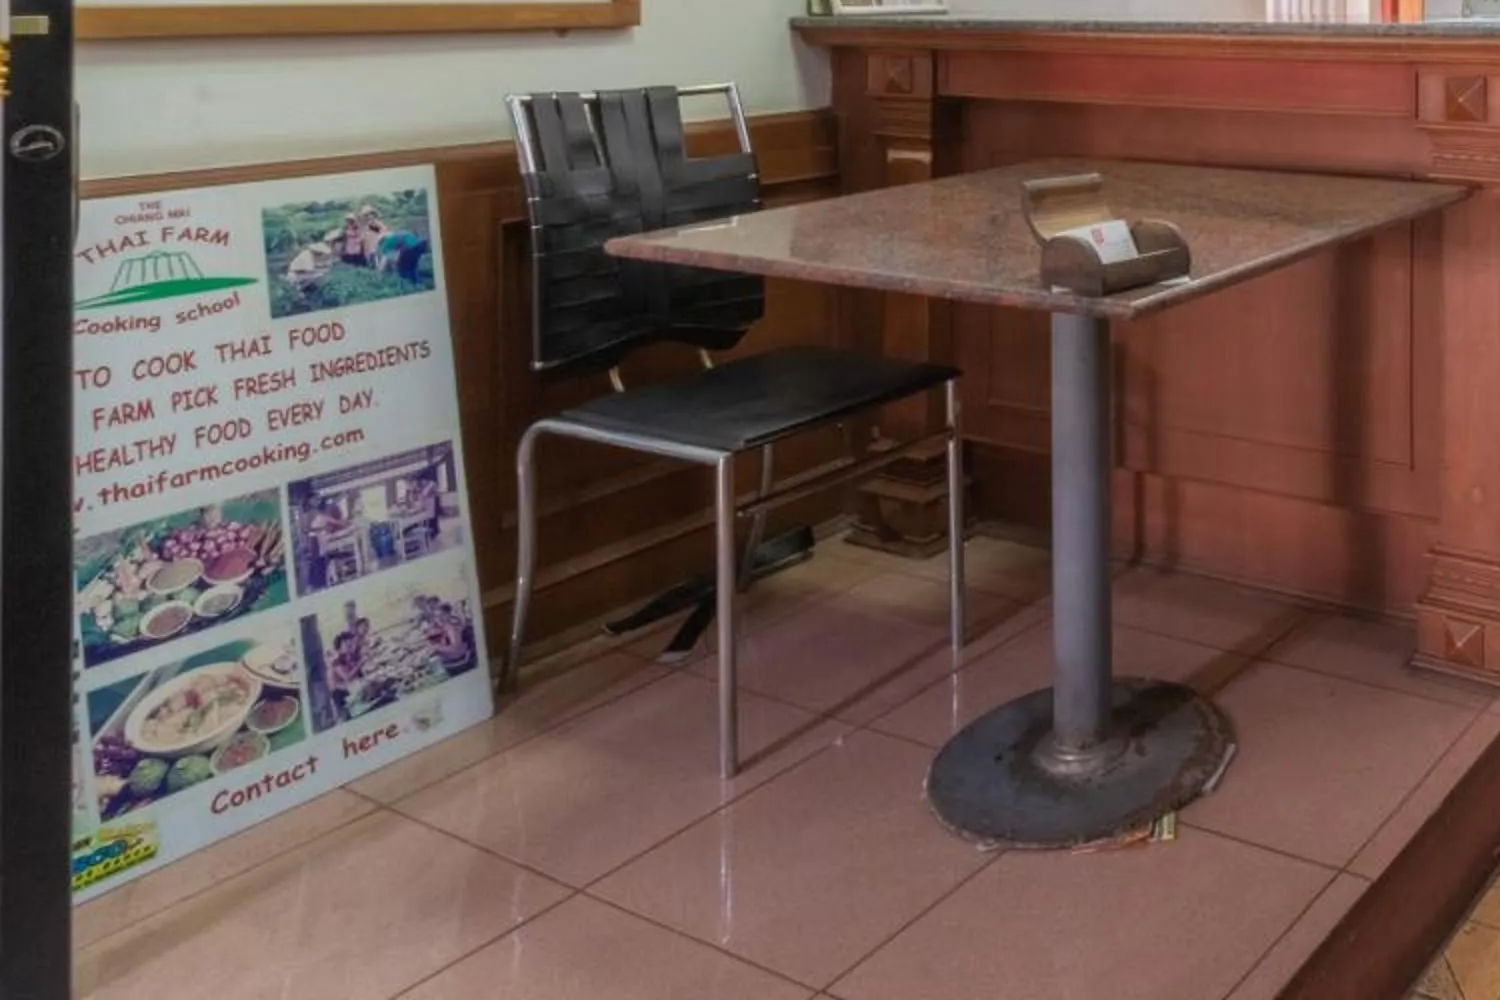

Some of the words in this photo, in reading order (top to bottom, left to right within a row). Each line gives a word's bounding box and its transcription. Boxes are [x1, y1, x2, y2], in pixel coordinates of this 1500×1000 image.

[139, 201, 161, 211] THE
[75, 231, 150, 264] THAI
[161, 226, 230, 246] FARM
[175, 291, 240, 325] school
[76, 366, 112, 390] TO
[133, 351, 196, 381] COOK
[215, 335, 271, 363] THAI
[289, 322, 345, 350] FOOD
[93, 399, 155, 431] FARM
[172, 385, 218, 412] PICK
[234, 369, 295, 400] FRESH
[308, 341, 430, 382] INGREDIENTS
[75, 434, 176, 476] HEALTHY
[195, 418, 250, 448] FOOD
[268, 401, 324, 431] EVERY
[210, 755, 319, 815] Contact
[342, 722, 399, 759] here
